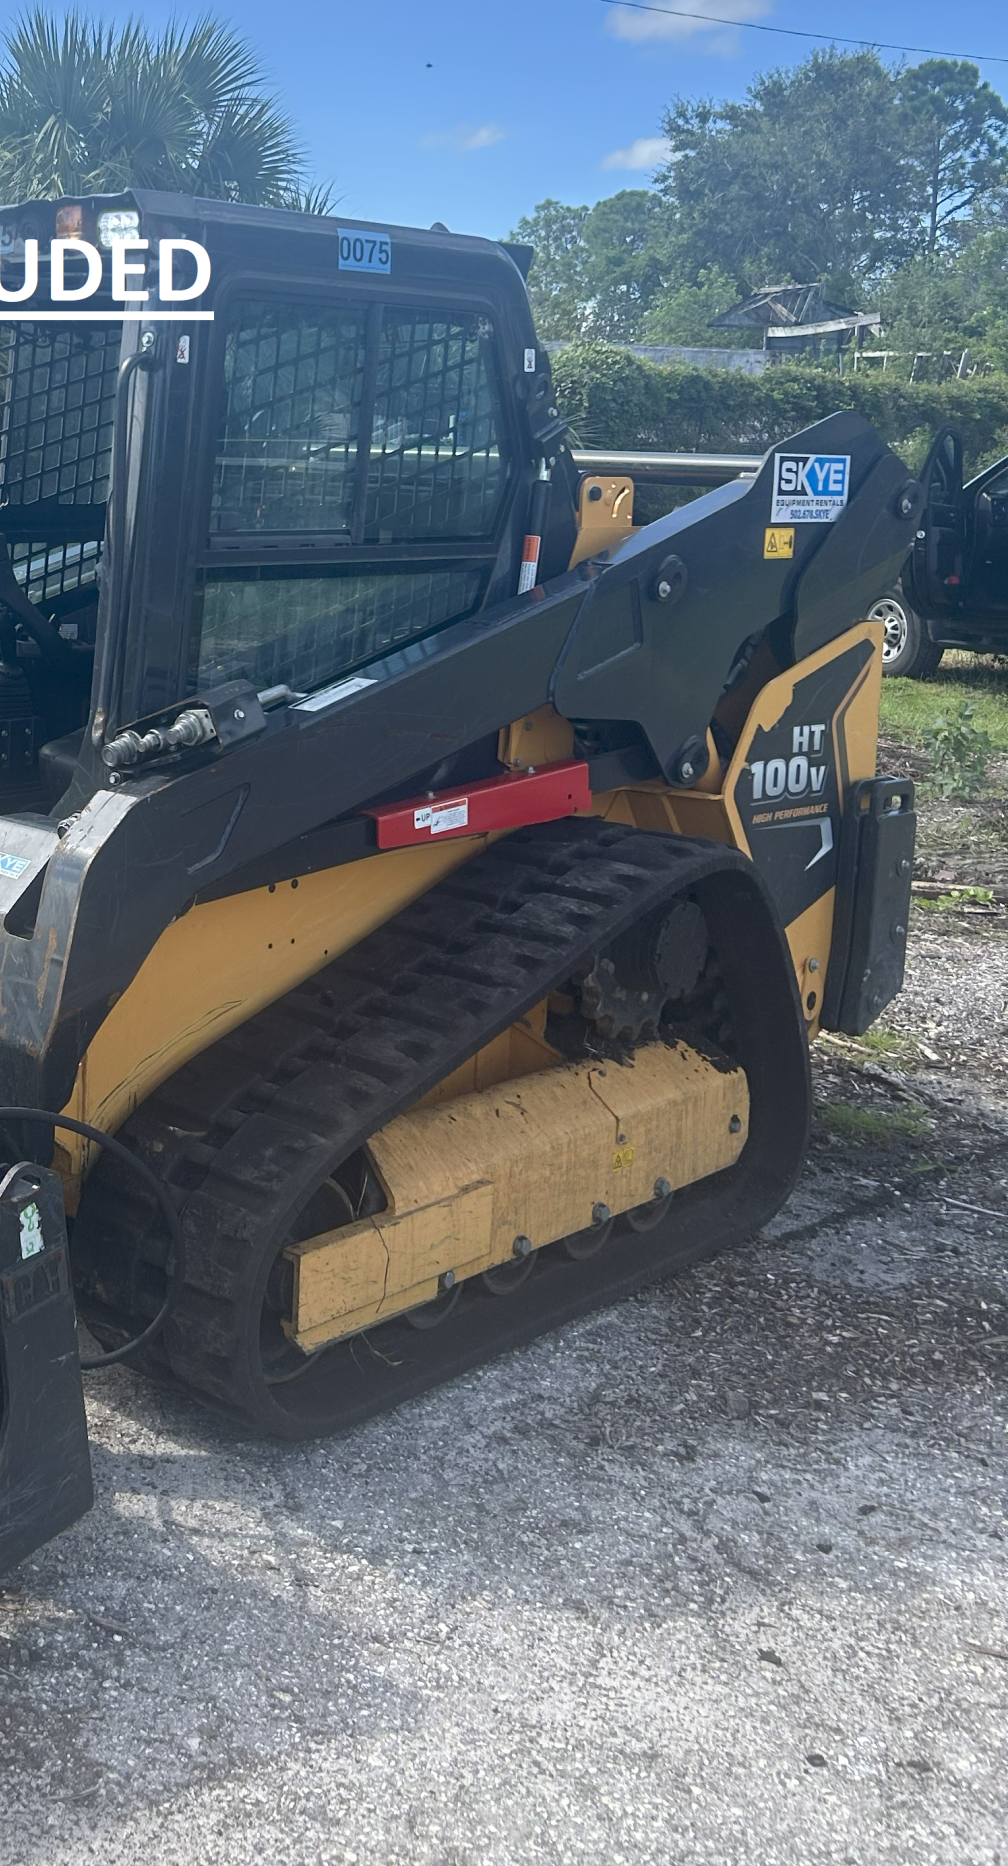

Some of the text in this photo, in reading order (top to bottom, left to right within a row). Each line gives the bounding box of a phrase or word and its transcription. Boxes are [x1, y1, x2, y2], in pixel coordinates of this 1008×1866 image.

[339, 236, 390, 266] 0075
[779, 461, 845, 492] SKYE
[775, 499, 844, 507] EQUIPMENT RENTALS
[792, 724, 826, 753] HT
[752, 803, 829, 824] HIGH PERFORMANCE
